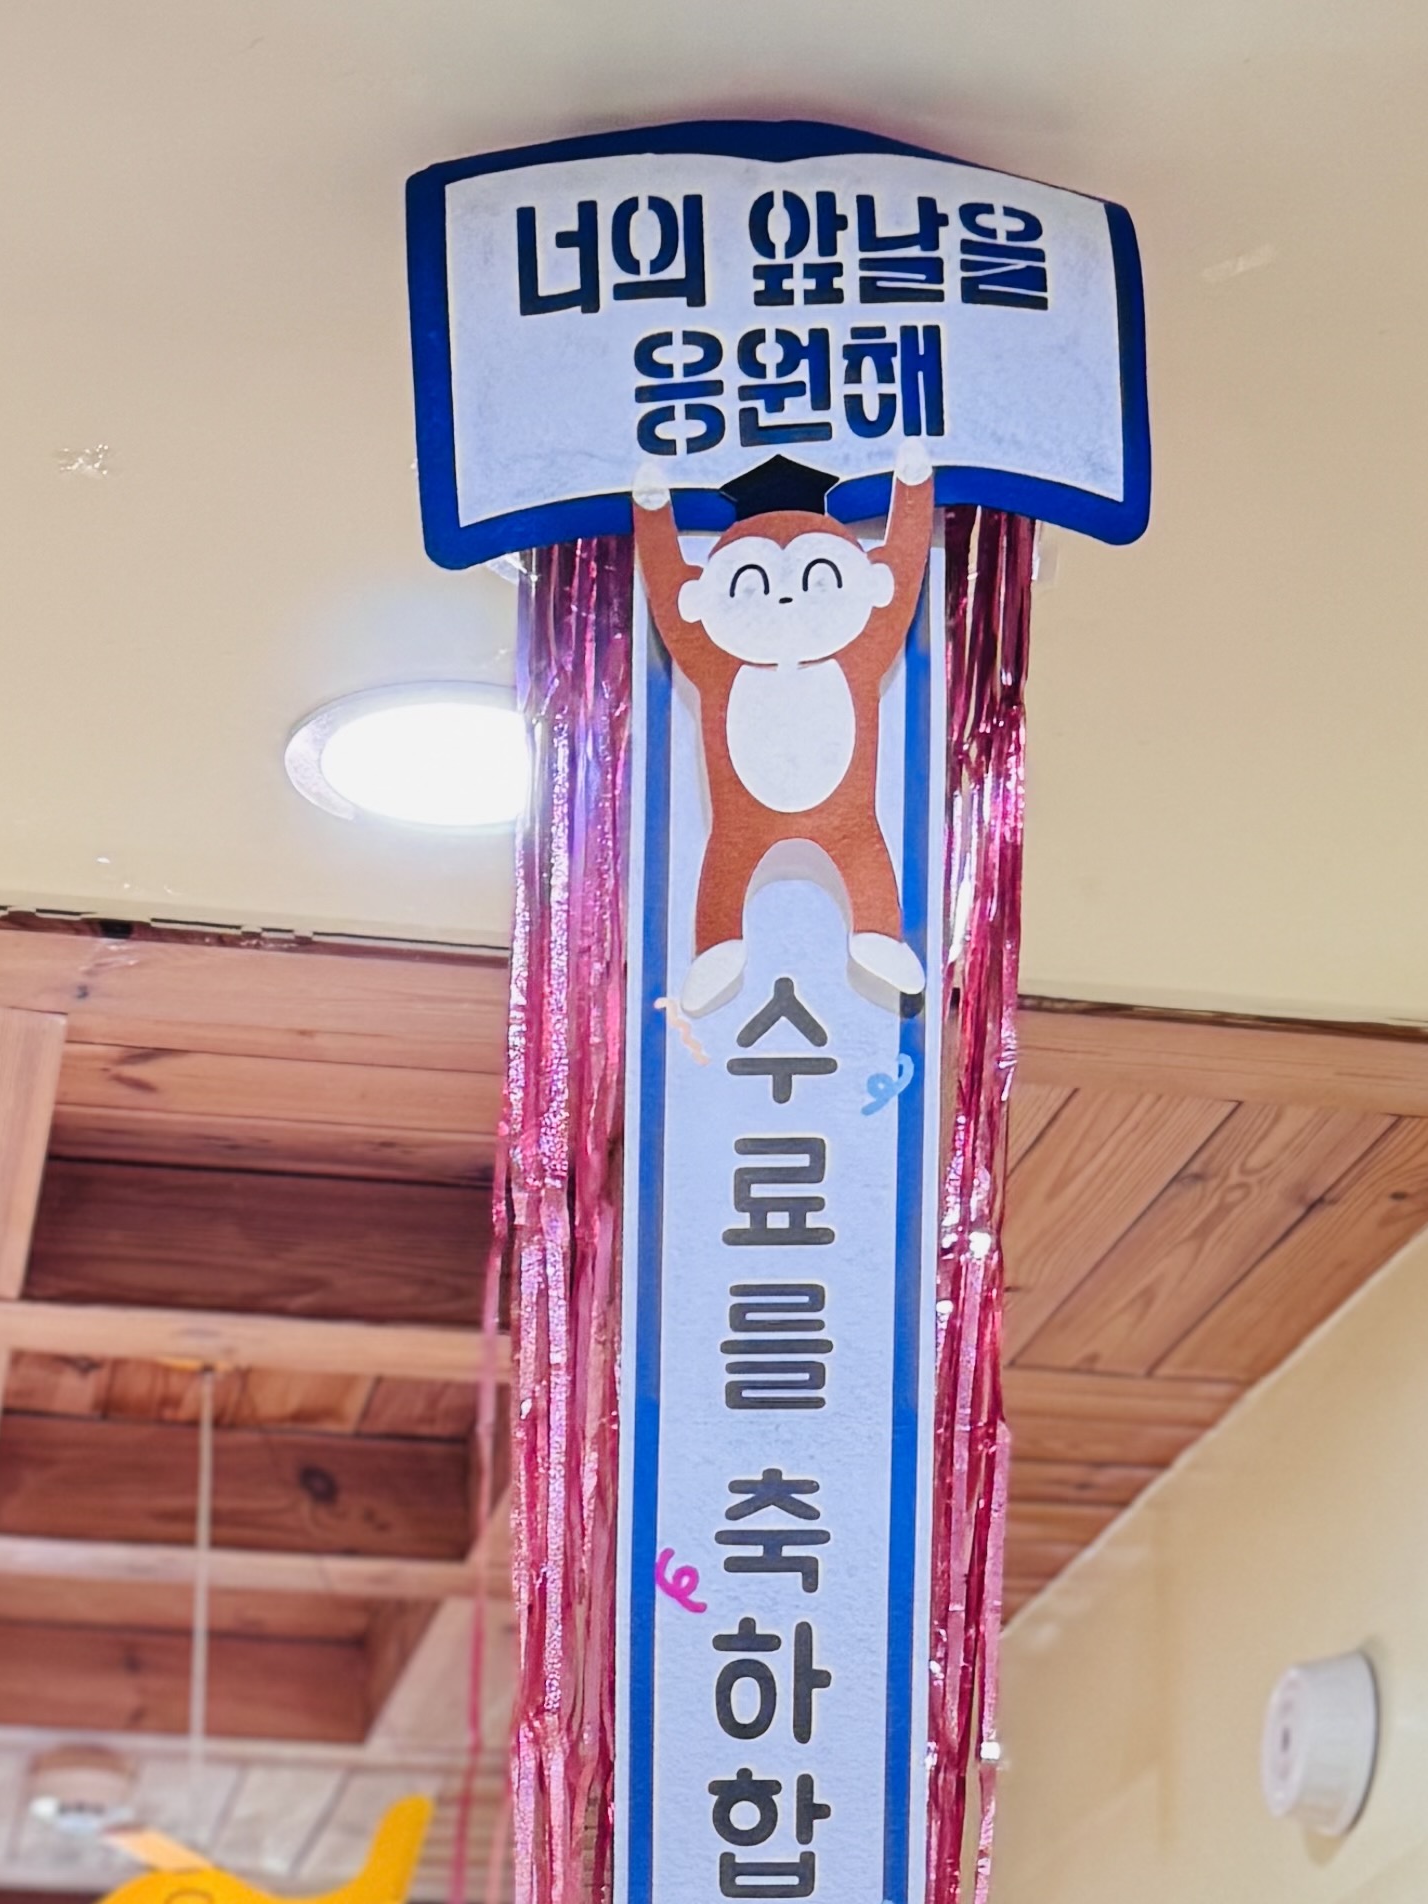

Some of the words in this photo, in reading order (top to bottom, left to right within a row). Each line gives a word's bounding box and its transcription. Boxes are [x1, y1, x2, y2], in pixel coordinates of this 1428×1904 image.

[516, 192, 707, 316] 너의
[748, 188, 1050, 312] 앞날을
[632, 323, 946, 456] 응원해
[719, 975, 839, 1411] 수료를
